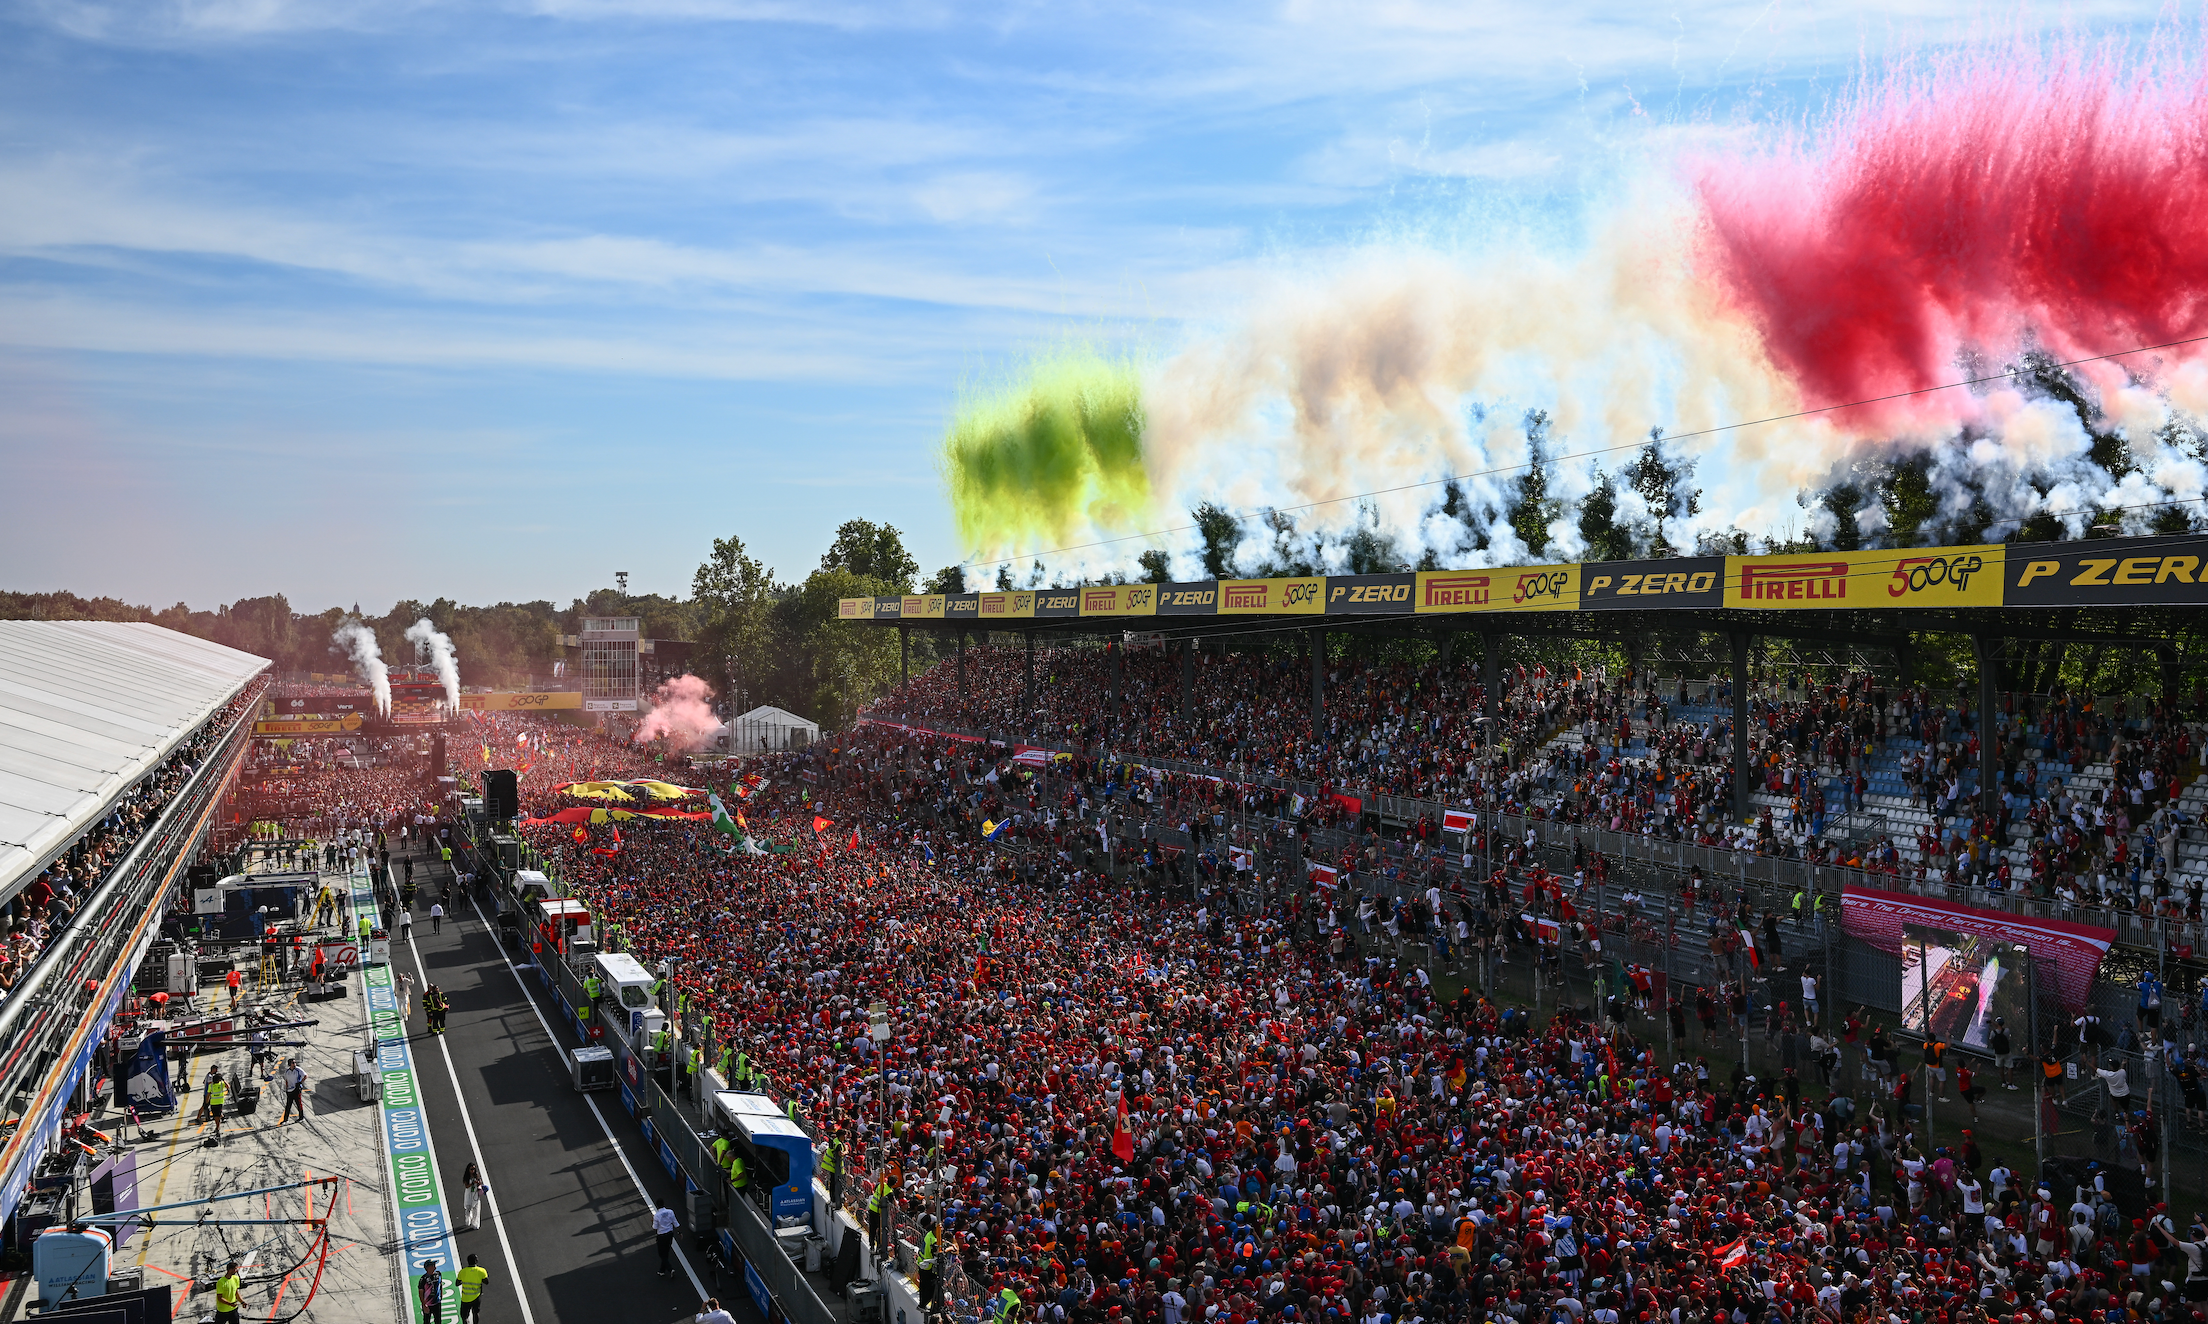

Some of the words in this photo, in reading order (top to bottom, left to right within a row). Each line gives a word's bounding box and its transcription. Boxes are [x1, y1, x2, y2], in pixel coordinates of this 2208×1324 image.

[1588, 576, 1612, 596] P
[1616, 572, 1716, 594] ZERO
[1740, 562, 1849, 600] PIRELLI
[1888, 556, 1982, 598] 500GP
[2016, 560, 2060, 587] P
[1160, 592, 1171, 606] P
[1172, 591, 1215, 605] ZERO
[1224, 585, 1268, 608] PIRELLI
[1282, 584, 1318, 608] 500GP
[1330, 587, 1346, 602] P
[1347, 584, 1410, 602] ZERO
[1426, 576, 1490, 606] PIRELLI
[1514, 572, 1568, 604] 500GP
[841, 601, 856, 615] PIRELLI
[875, 603, 881, 612] P
[881, 602, 900, 612] ZERO
[904, 598, 922, 614] PIRELLI
[946, 601, 952, 610] P
[952, 600, 977, 611] ZERO
[982, 596, 1005, 613] PIRELLI
[1037, 598, 1045, 609] P
[1046, 597, 1077, 609] ZERO
[1085, 591, 1116, 611] PIRELLI
[1126, 589, 1152, 610] 500GP
[508, 695, 549, 708] 500GP
[265, 723, 301, 731] PIRELLI
[1872, 902, 1895, 912] The
[1896, 907, 1946, 921] Official
[1946, 917, 1994, 930] Ferrari
[1996, 925, 2054, 942] Passion
[384, 1072, 413, 1105] aramco
[391, 1110, 422, 1149] aramco
[1415, 1145, 1424, 1153] 16
[398, 1156, 432, 1203] aramco
[406, 1211, 446, 1269] aramco
